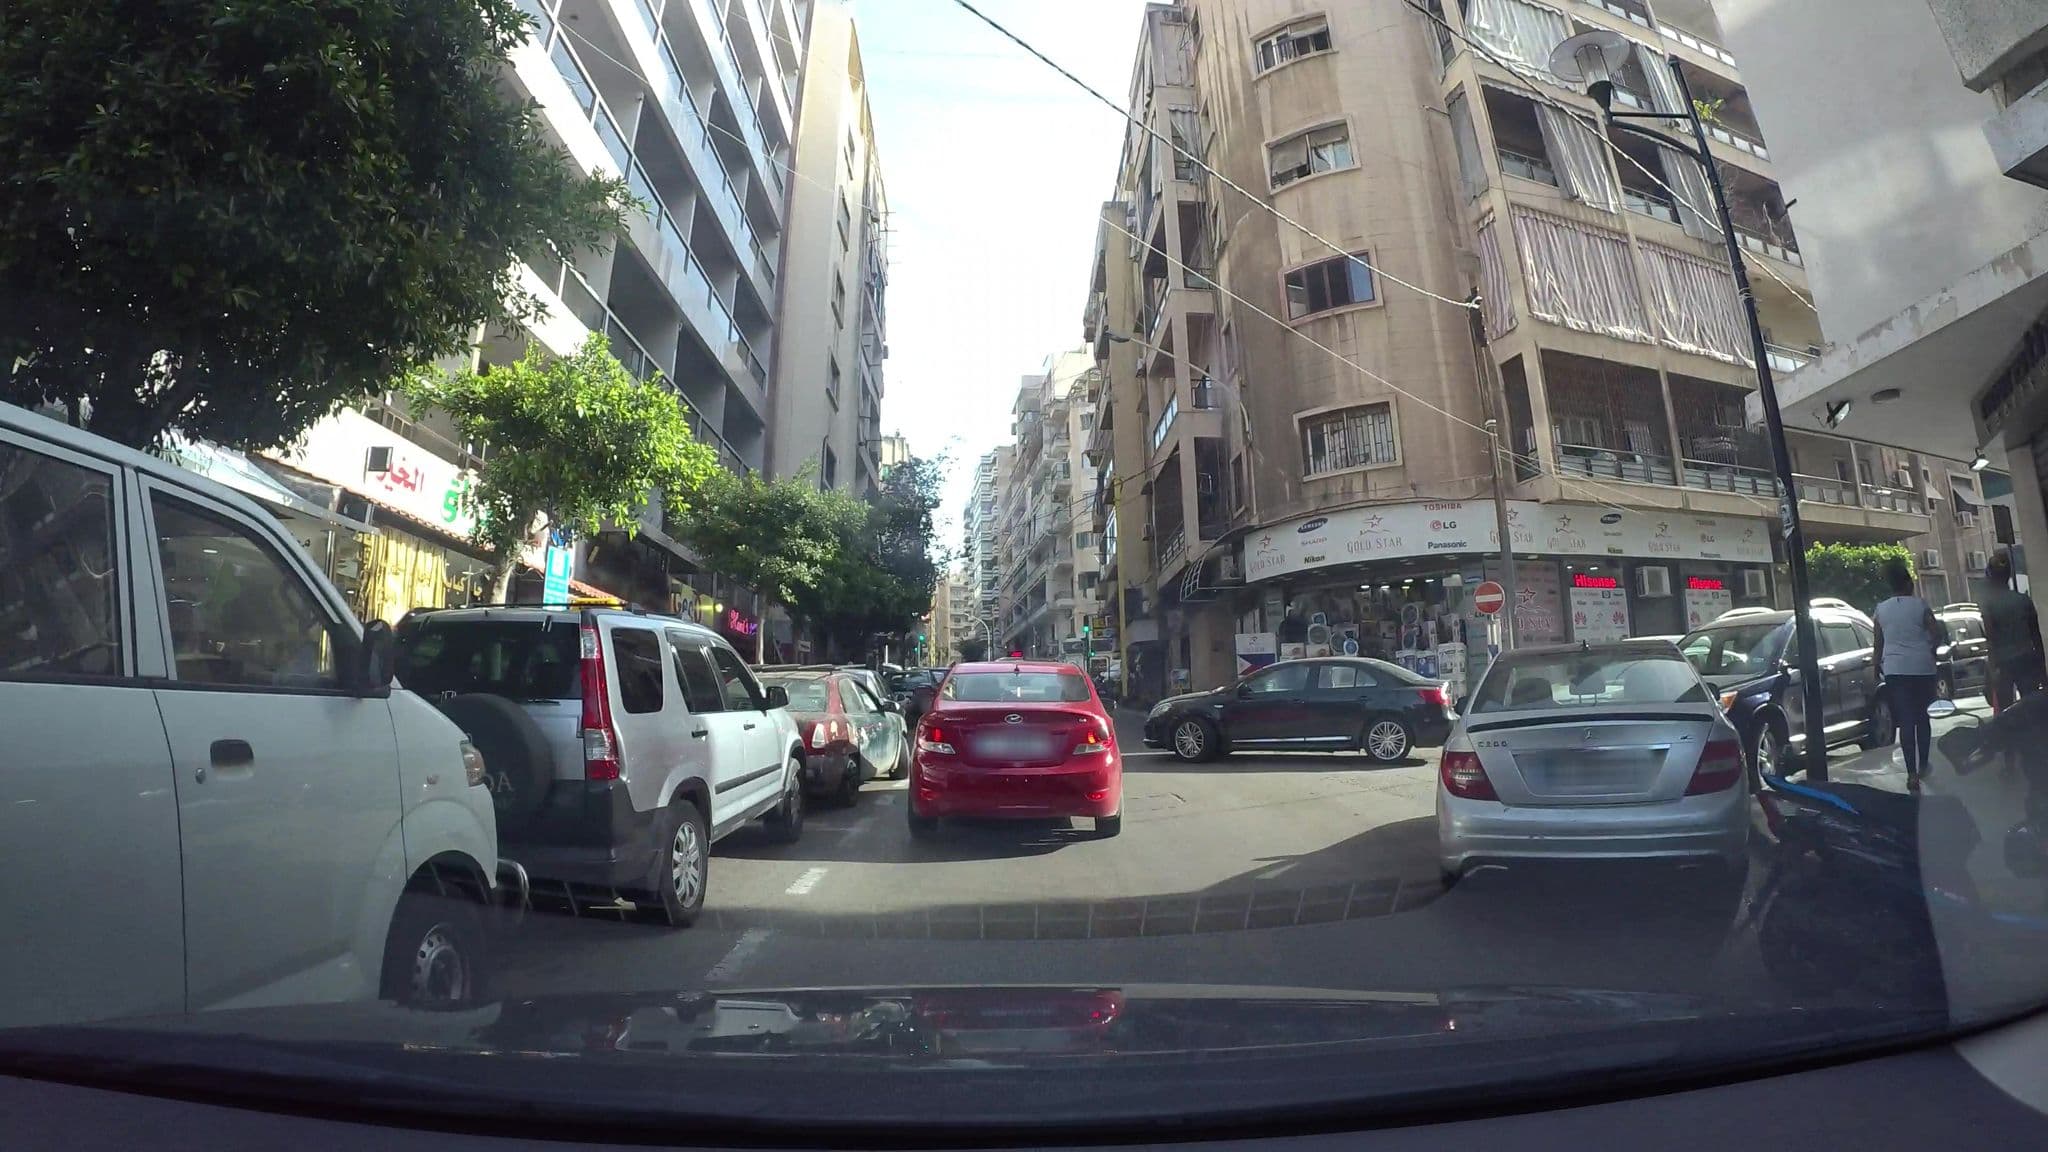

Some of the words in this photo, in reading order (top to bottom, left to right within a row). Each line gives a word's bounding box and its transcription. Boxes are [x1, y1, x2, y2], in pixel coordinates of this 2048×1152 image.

[1424, 502, 1462, 511] TOSHIBA
[1442, 521, 1458, 530] LG
[1347, 540, 1371, 554] GOLD
[1376, 537, 1402, 549] STAR
[1427, 539, 1467, 550] Panasonic
[1266, 554, 1286, 569] STAR
[1304, 555, 1325, 565] Nikon
